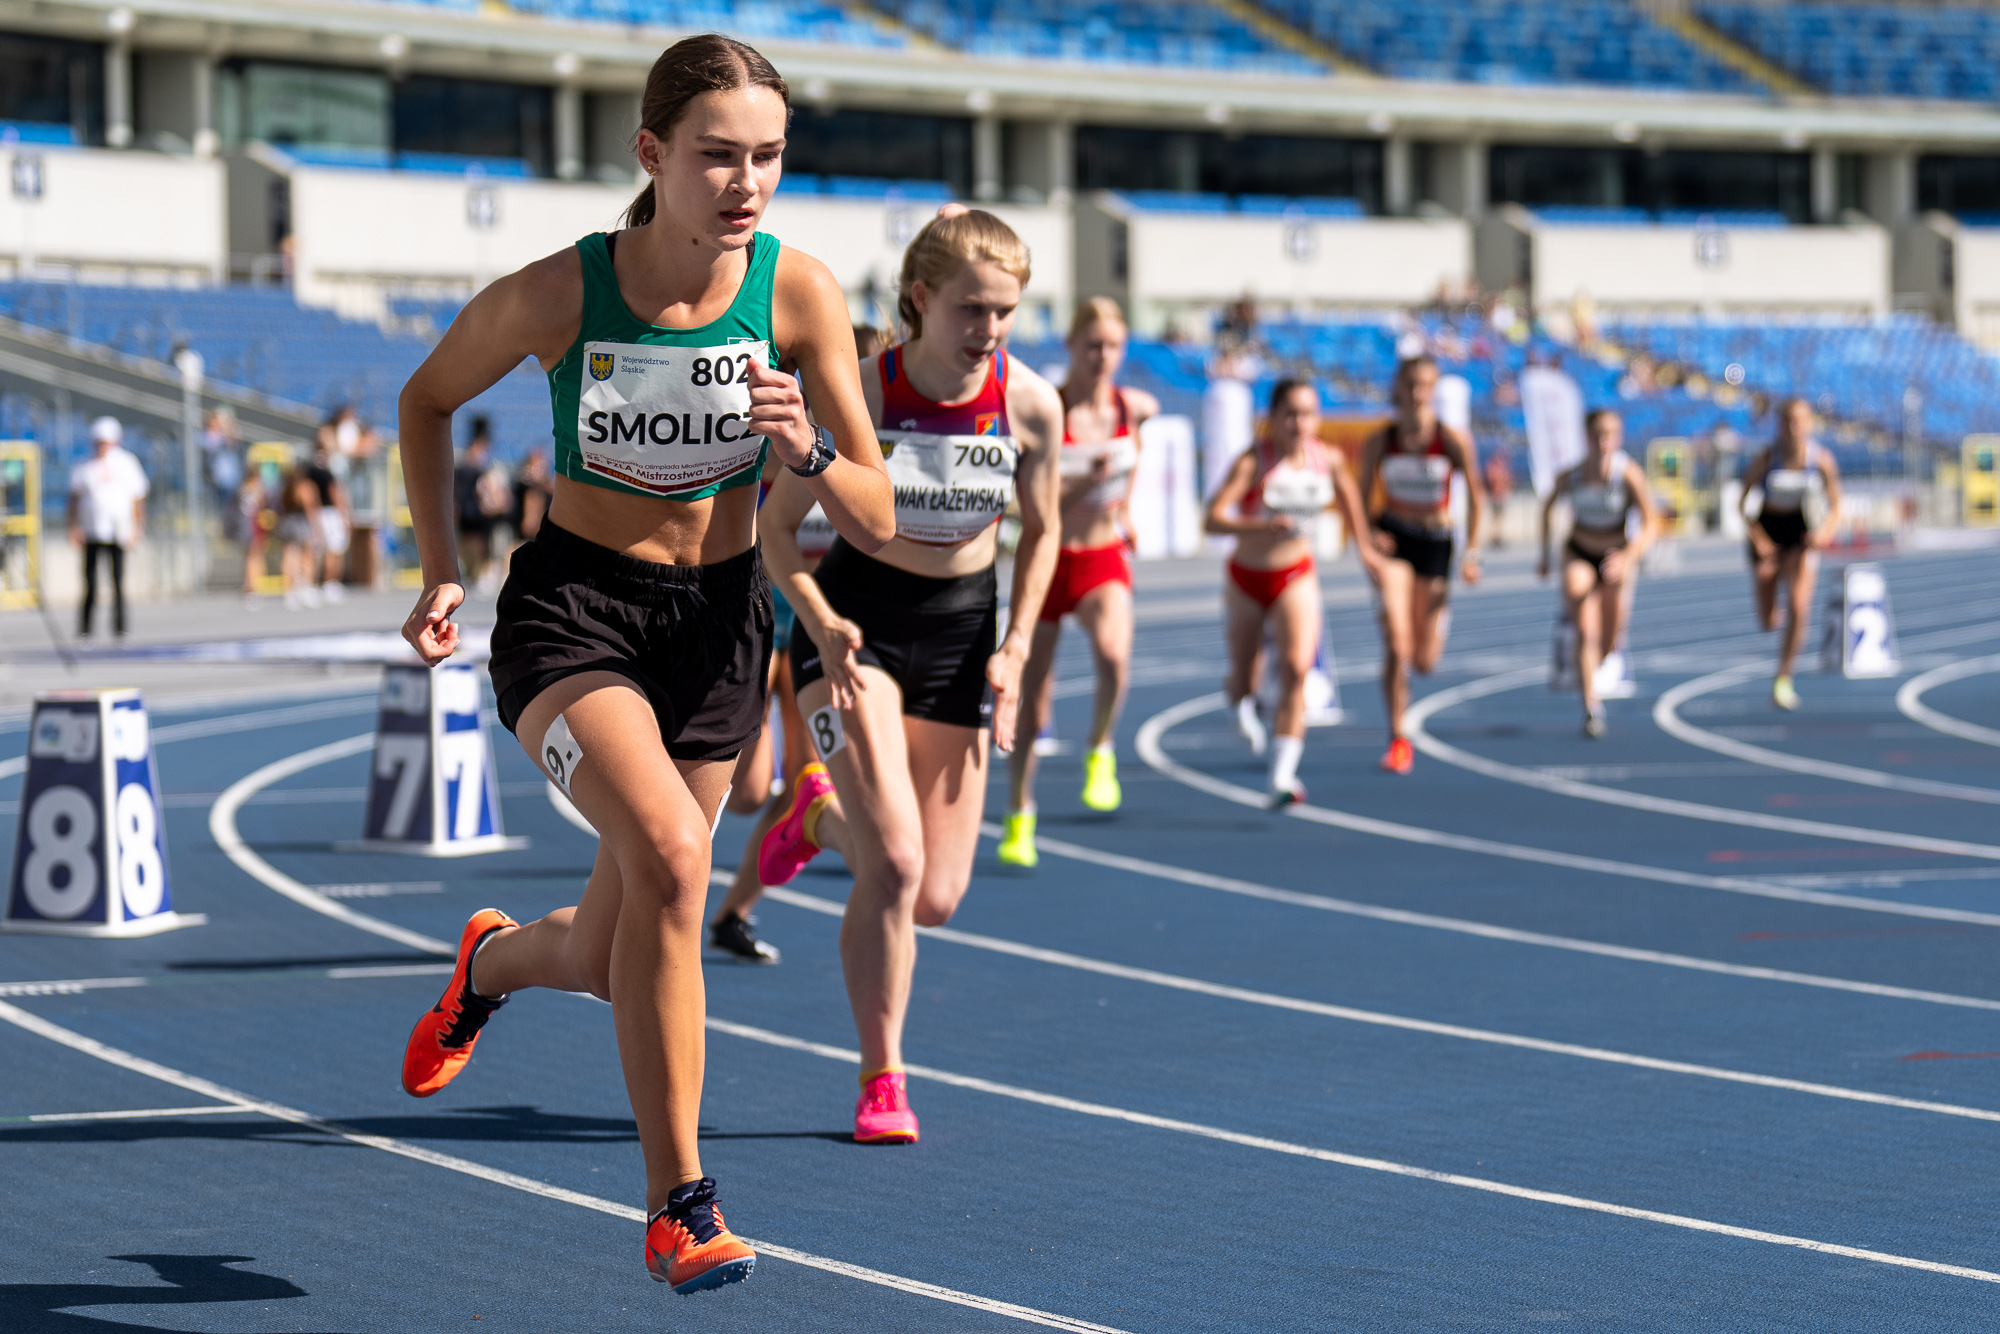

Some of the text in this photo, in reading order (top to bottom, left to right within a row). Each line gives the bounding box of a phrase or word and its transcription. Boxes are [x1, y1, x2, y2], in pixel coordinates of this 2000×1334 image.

[620, 365, 646, 374] Śląskie
[621, 356, 670, 366] Województwo
[691, 353, 752, 386] 802
[636, 468, 703, 481] Mistrzostwa
[707, 459, 737, 474] Polski
[739, 450, 758, 462] U18
[644, 462, 680, 471] Olimpiada
[681, 461, 711, 470] Młodzieży
[954, 445, 1003, 467] 700
[606, 469, 649, 488] CHORZÓW
[894, 481, 1005, 512] WAK ŁAŻEWSKA
[1849, 606, 1889, 670] 2
[814, 711, 835, 755] 8
[376, 734, 428, 840] 7
[440, 730, 485, 839] 7
[23, 784, 98, 920] 8
[115, 782, 165, 918] 8
